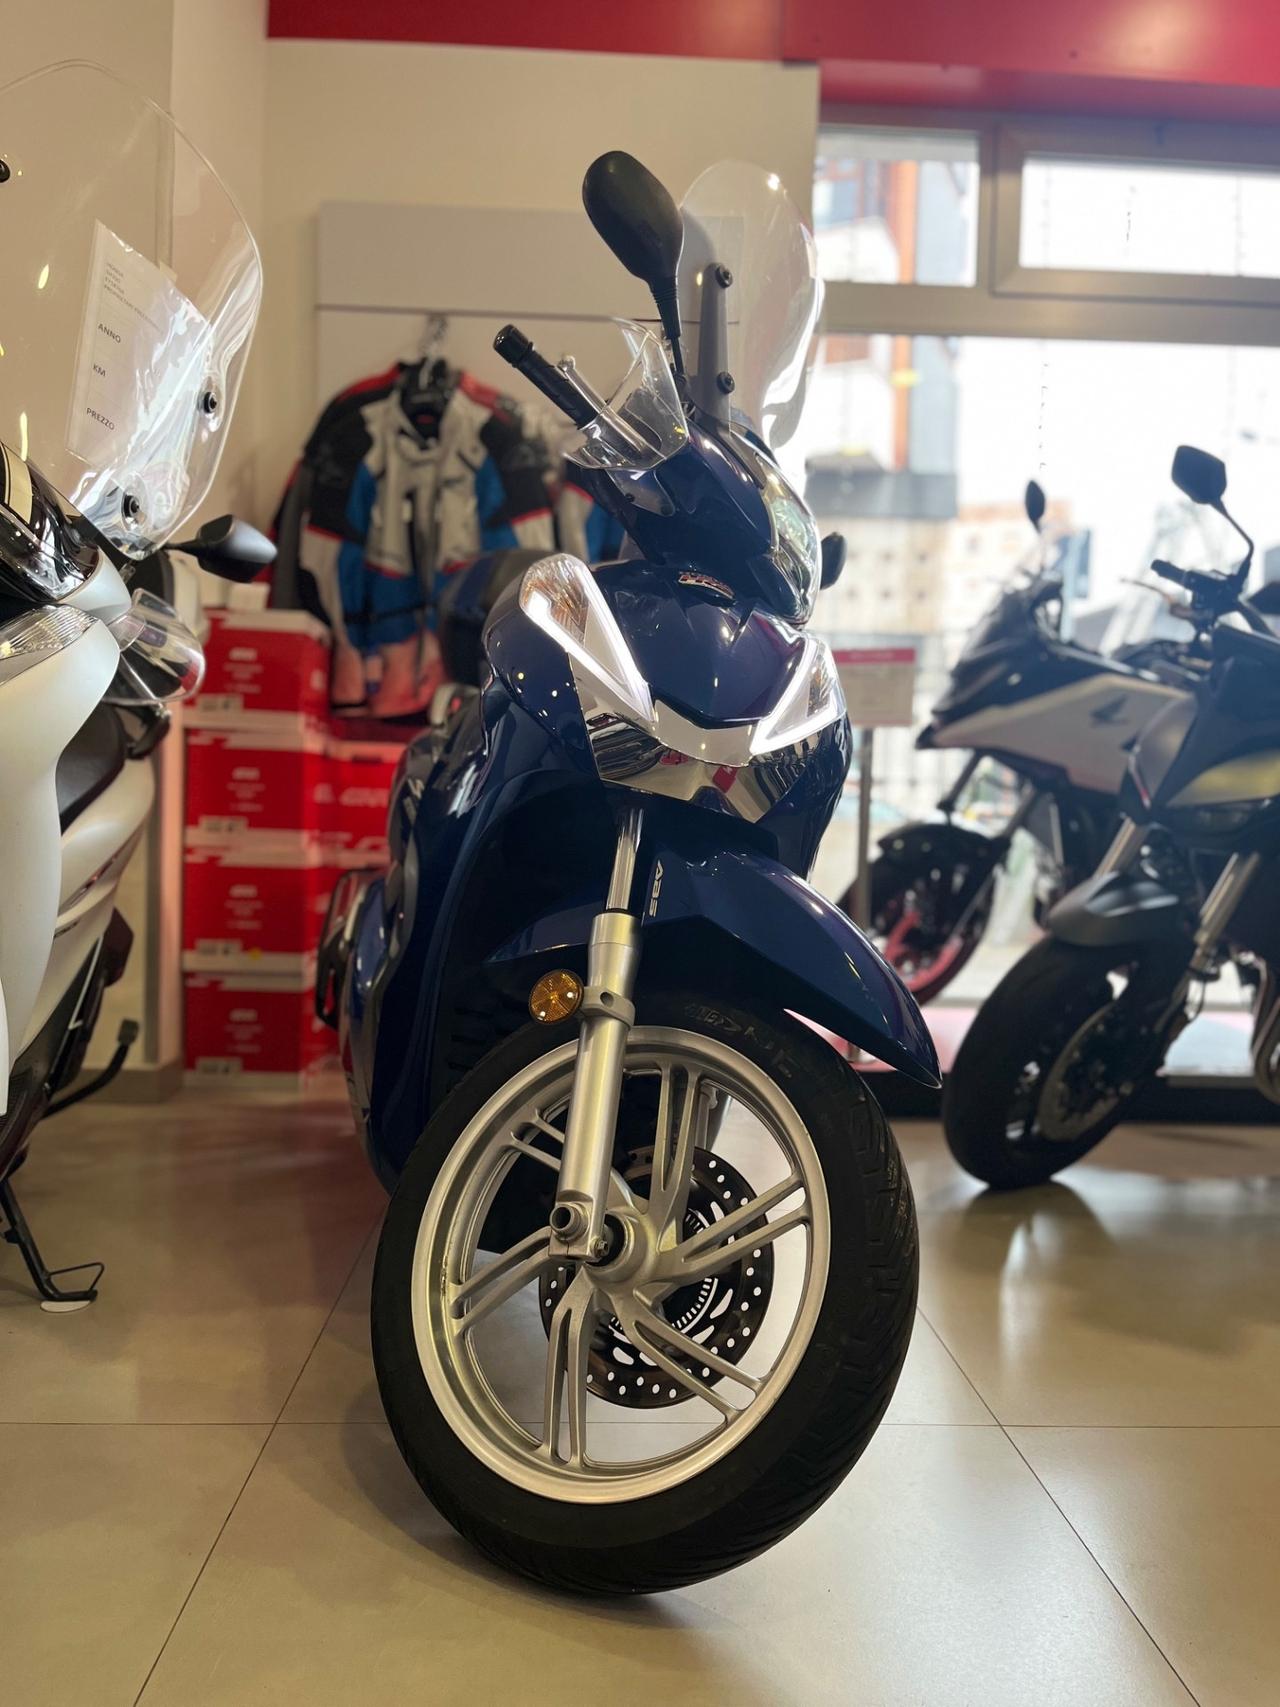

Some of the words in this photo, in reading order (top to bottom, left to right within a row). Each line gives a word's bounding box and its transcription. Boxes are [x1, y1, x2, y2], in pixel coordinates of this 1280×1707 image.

[98, 323, 121, 343] ANNO
[93, 363, 106, 377] KM
[86, 407, 114, 430] PREZZO
[649, 859, 664, 917] ABS
